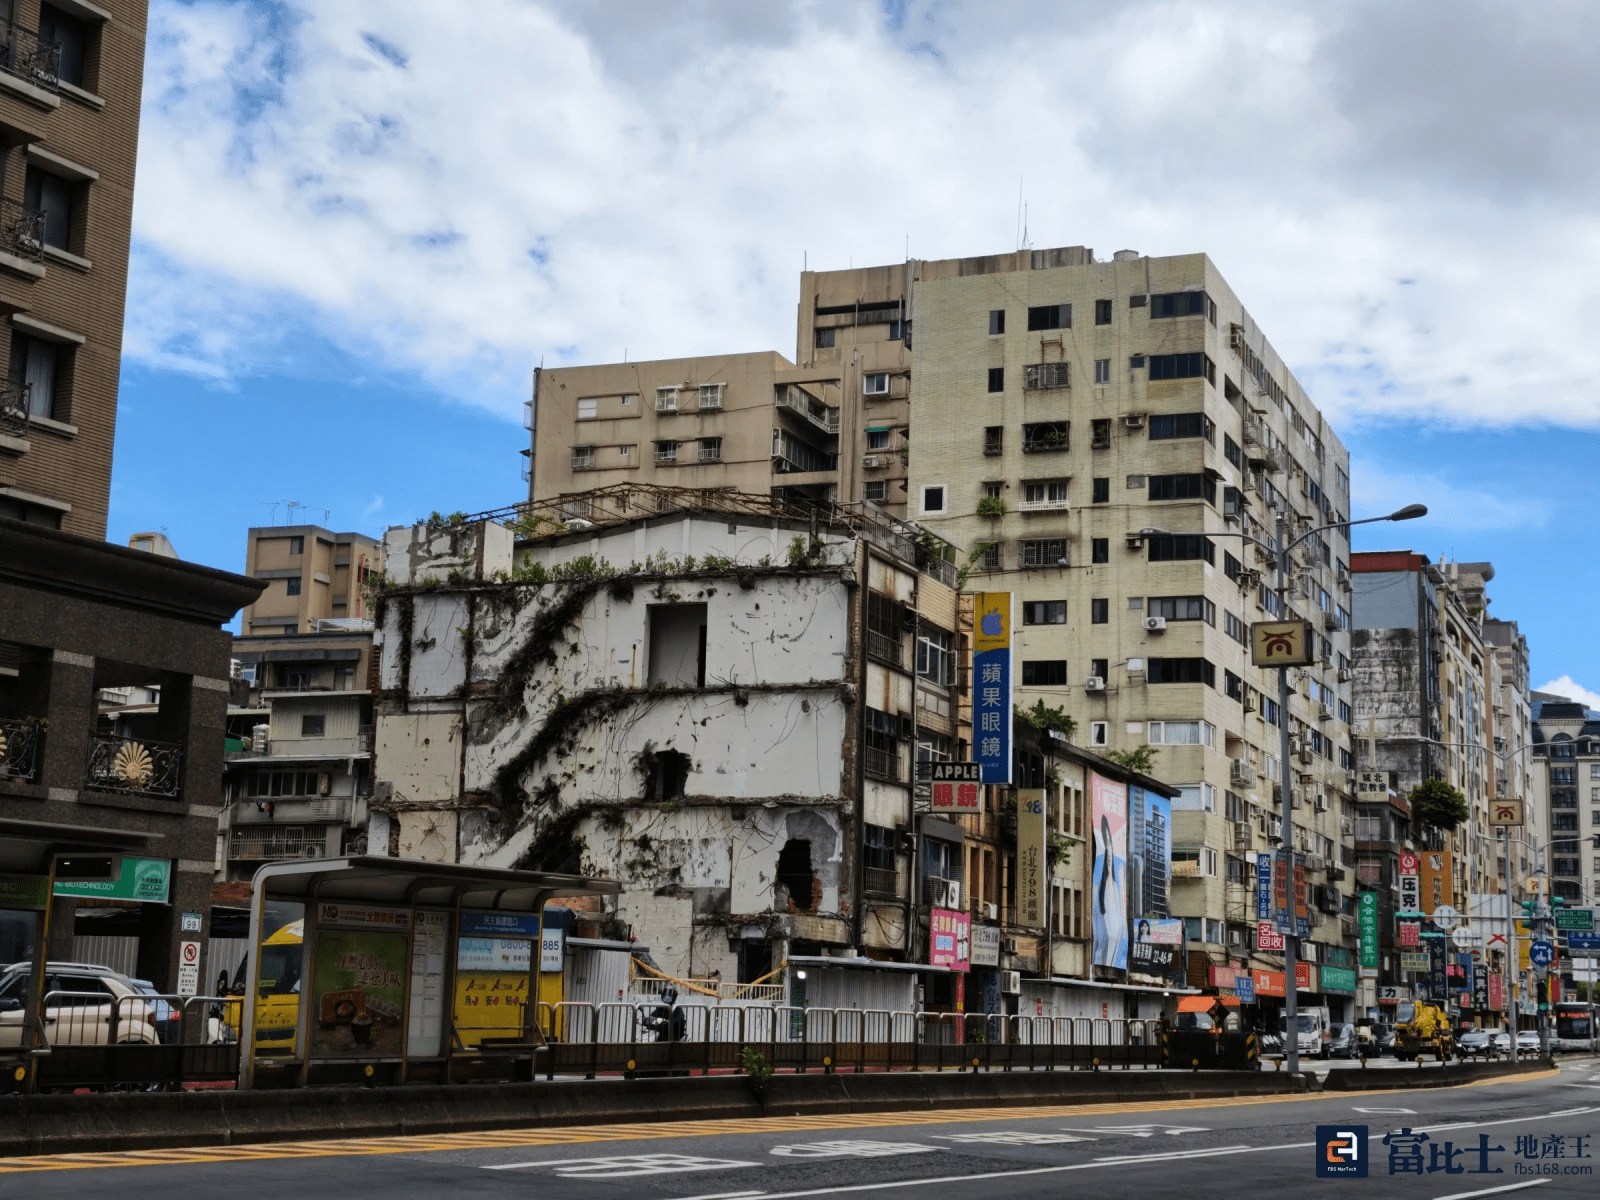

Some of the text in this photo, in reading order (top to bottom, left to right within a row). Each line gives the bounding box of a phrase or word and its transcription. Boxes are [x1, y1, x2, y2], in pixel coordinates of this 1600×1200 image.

[981, 663, 1002, 757] 蘋果眼鏡
[934, 765, 978, 779] APPLE
[1020, 797, 1042, 813] 798
[186, 920, 197, 929] 99
[542, 940, 560, 951] 885
[1260, 936, 1282, 948] 回收
